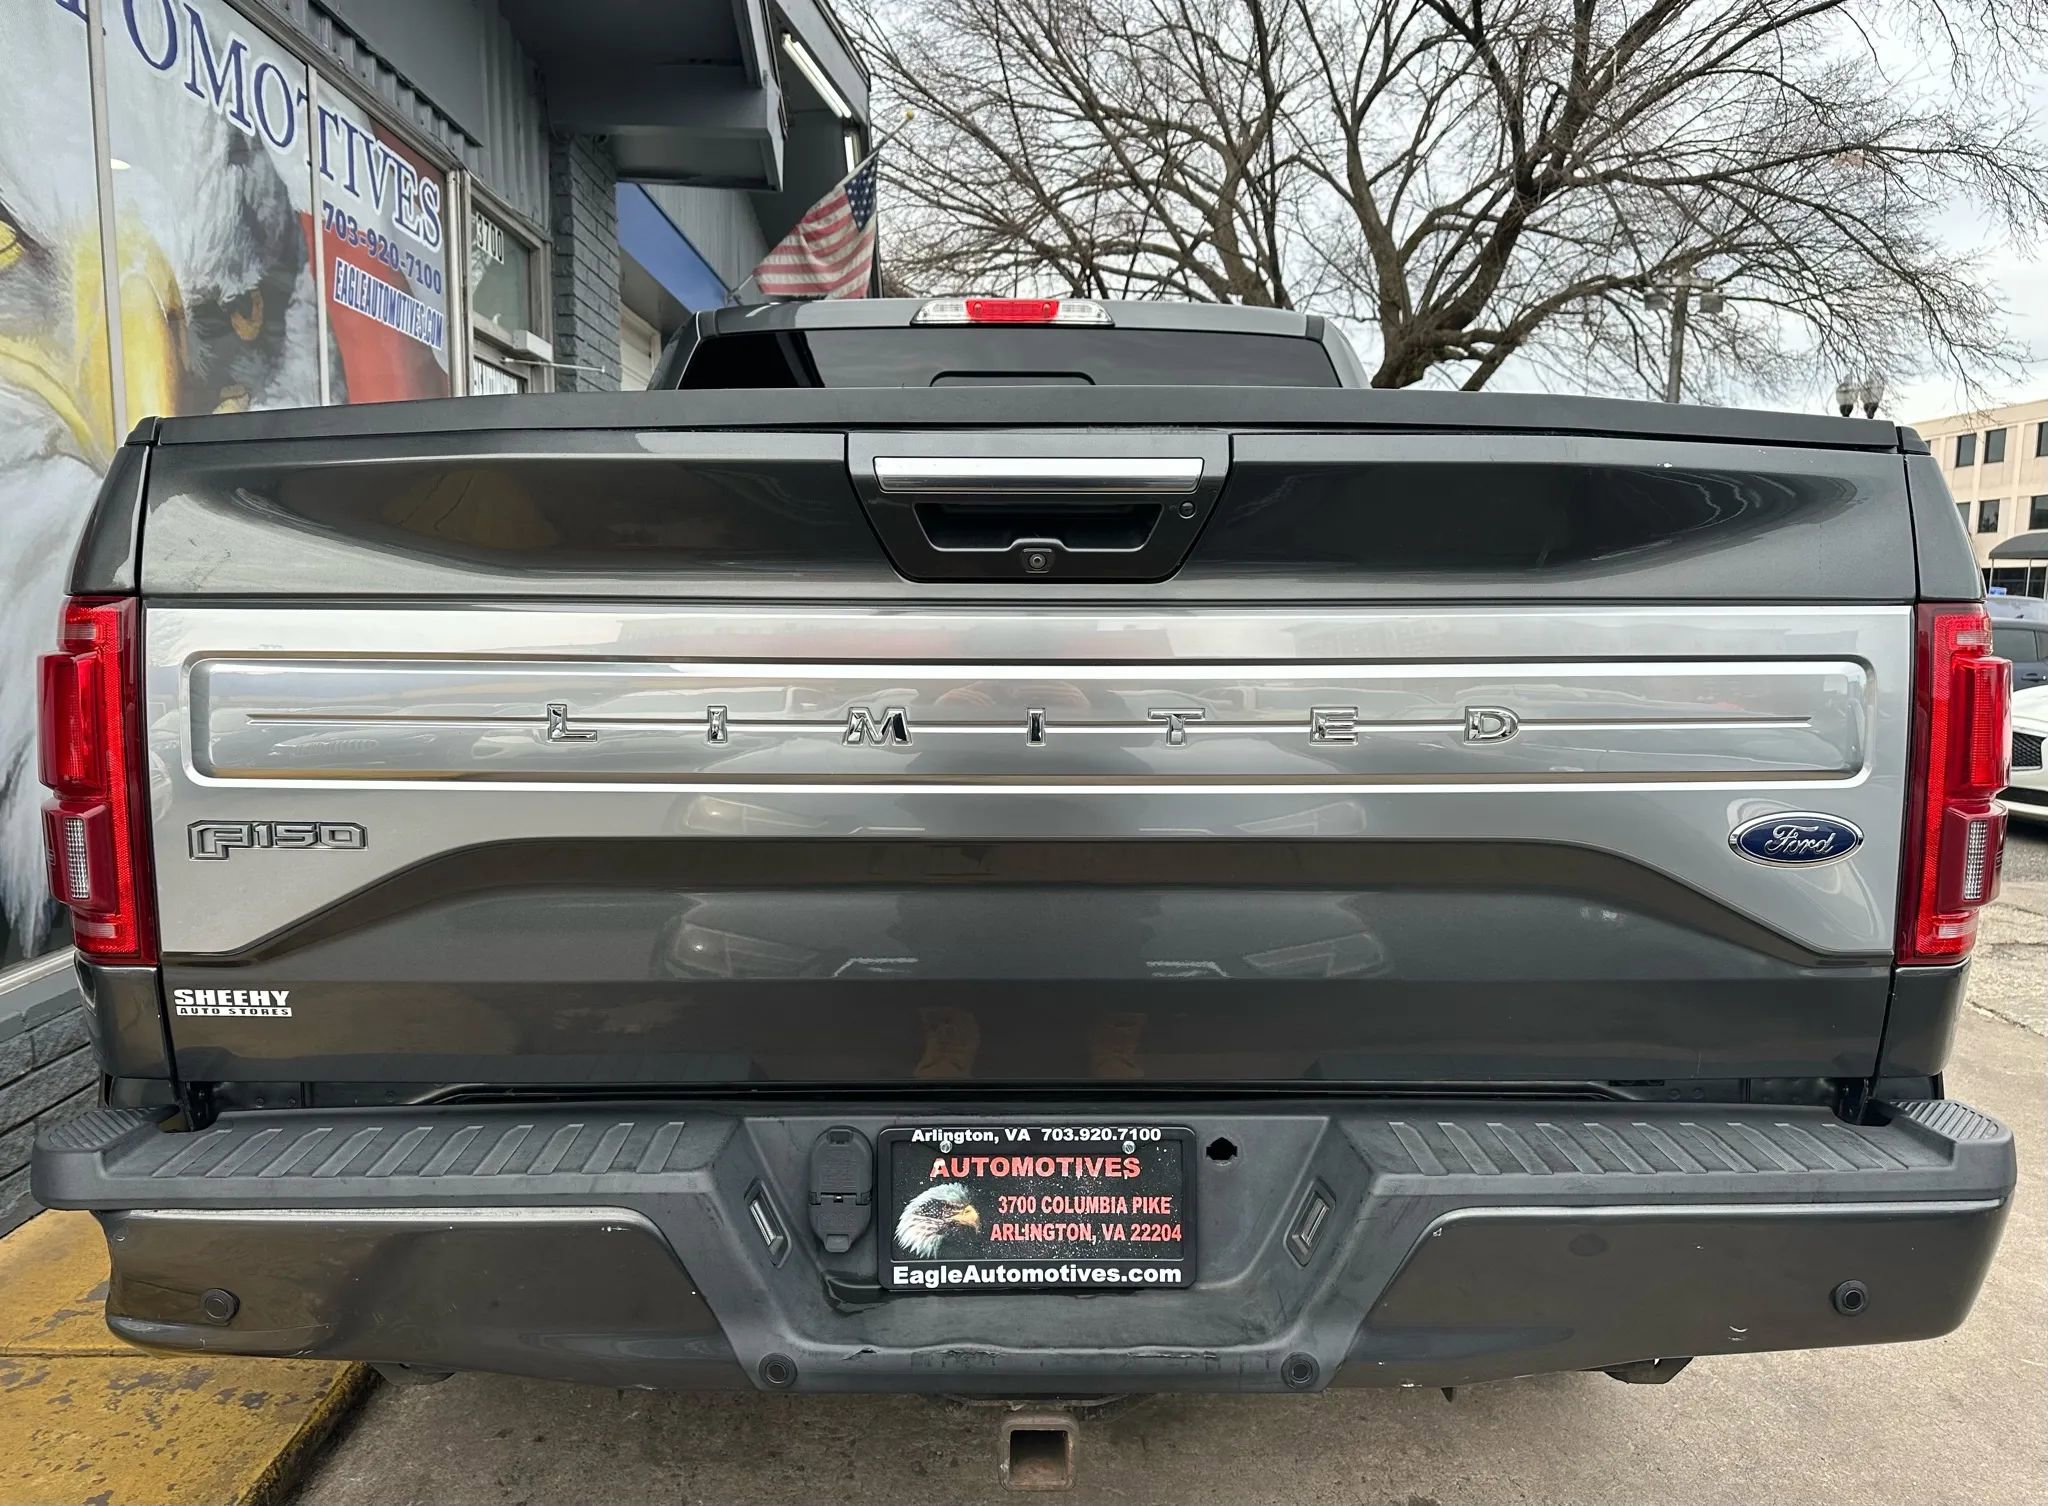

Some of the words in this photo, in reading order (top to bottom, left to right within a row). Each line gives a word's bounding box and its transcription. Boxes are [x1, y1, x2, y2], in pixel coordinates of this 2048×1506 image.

[56, 0, 440, 247] OMOTIVES
[322, 200, 442, 295] 703-920-7100
[476, 212, 504, 264] 3700
[334, 259, 443, 349] EAGLEAUTOMOTIVES.COM
[547, 703, 1519, 746] LIMITED
[187, 820, 368, 861] F150
[1764, 824, 1836, 855] Ford
[173, 989, 290, 1006] SHEEHY
[179, 1007, 221, 1015] AUTO
[228, 1008, 289, 1016] STORES
[911, 1129, 1000, 1144] Arlington,
[1004, 1128, 1031, 1142] VA
[1041, 1128, 1162, 1141] 703.920.7100
[929, 1157, 1141, 1178] AUTOMOTIVES
[998, 1196, 1036, 1214] 3700
[1041, 1196, 1127, 1215] COLUMBIA
[1132, 1196, 1171, 1215] PIKE
[989, 1223, 1097, 1244] ARLINGTON,
[1102, 1223, 1126, 1241] VA
[1130, 1223, 1182, 1242] 22204
[893, 1265, 1182, 1288] EagleAutomotives.com
